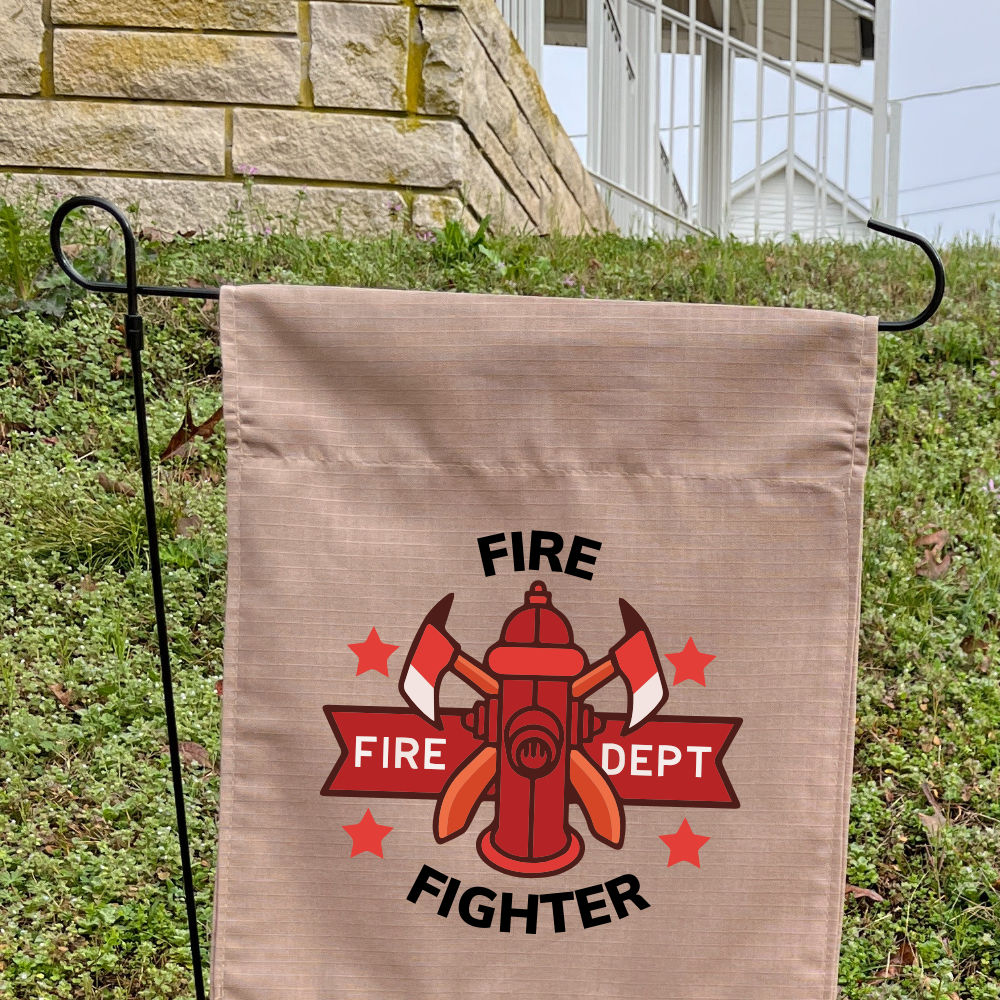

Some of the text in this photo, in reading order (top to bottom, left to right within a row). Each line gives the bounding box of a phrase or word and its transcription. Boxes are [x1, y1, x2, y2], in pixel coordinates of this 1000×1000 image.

[477, 530, 603, 582] FIRE
[353, 735, 714, 779] FIRE DEPT
[406, 864, 651, 934] FIGHTER
